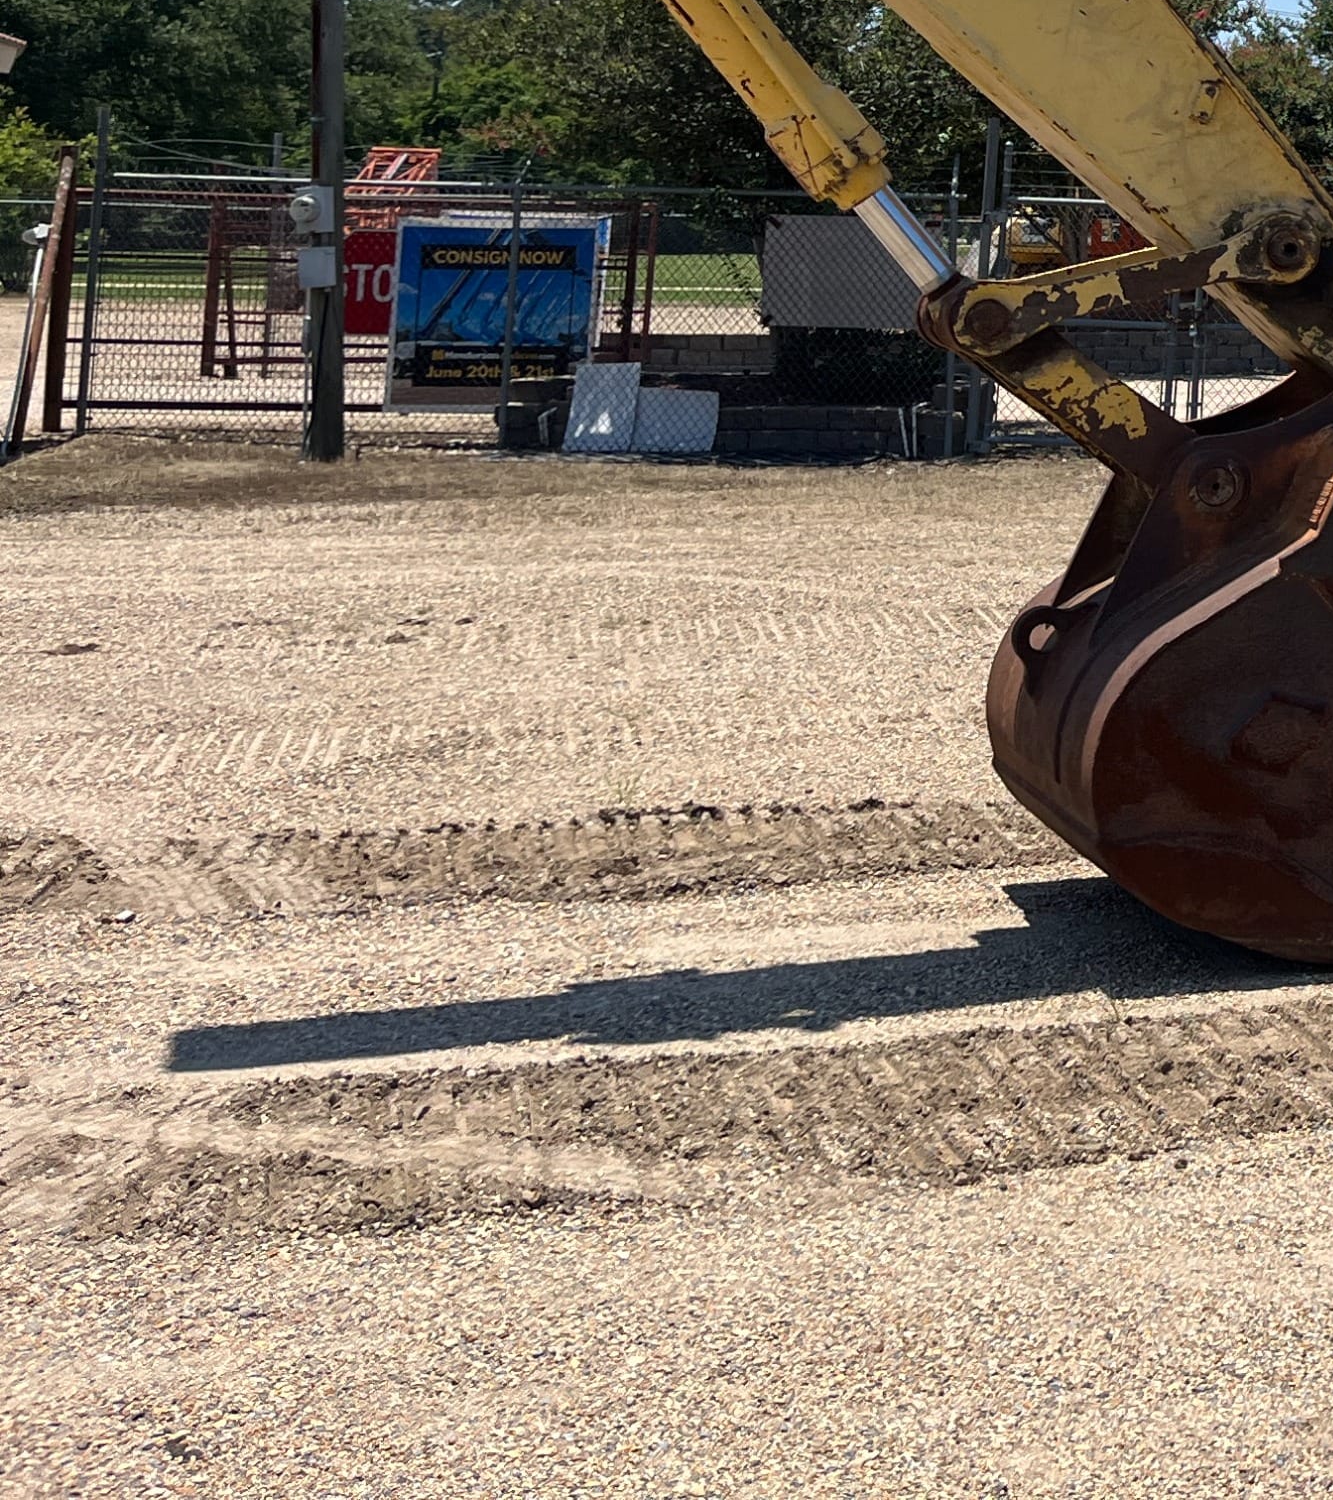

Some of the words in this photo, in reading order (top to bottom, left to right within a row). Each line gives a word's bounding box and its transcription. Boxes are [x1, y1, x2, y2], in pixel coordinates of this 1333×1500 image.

[432, 250, 512, 266] CONSIGN
[519, 251, 565, 266] NOW
[425, 365, 463, 378] June
